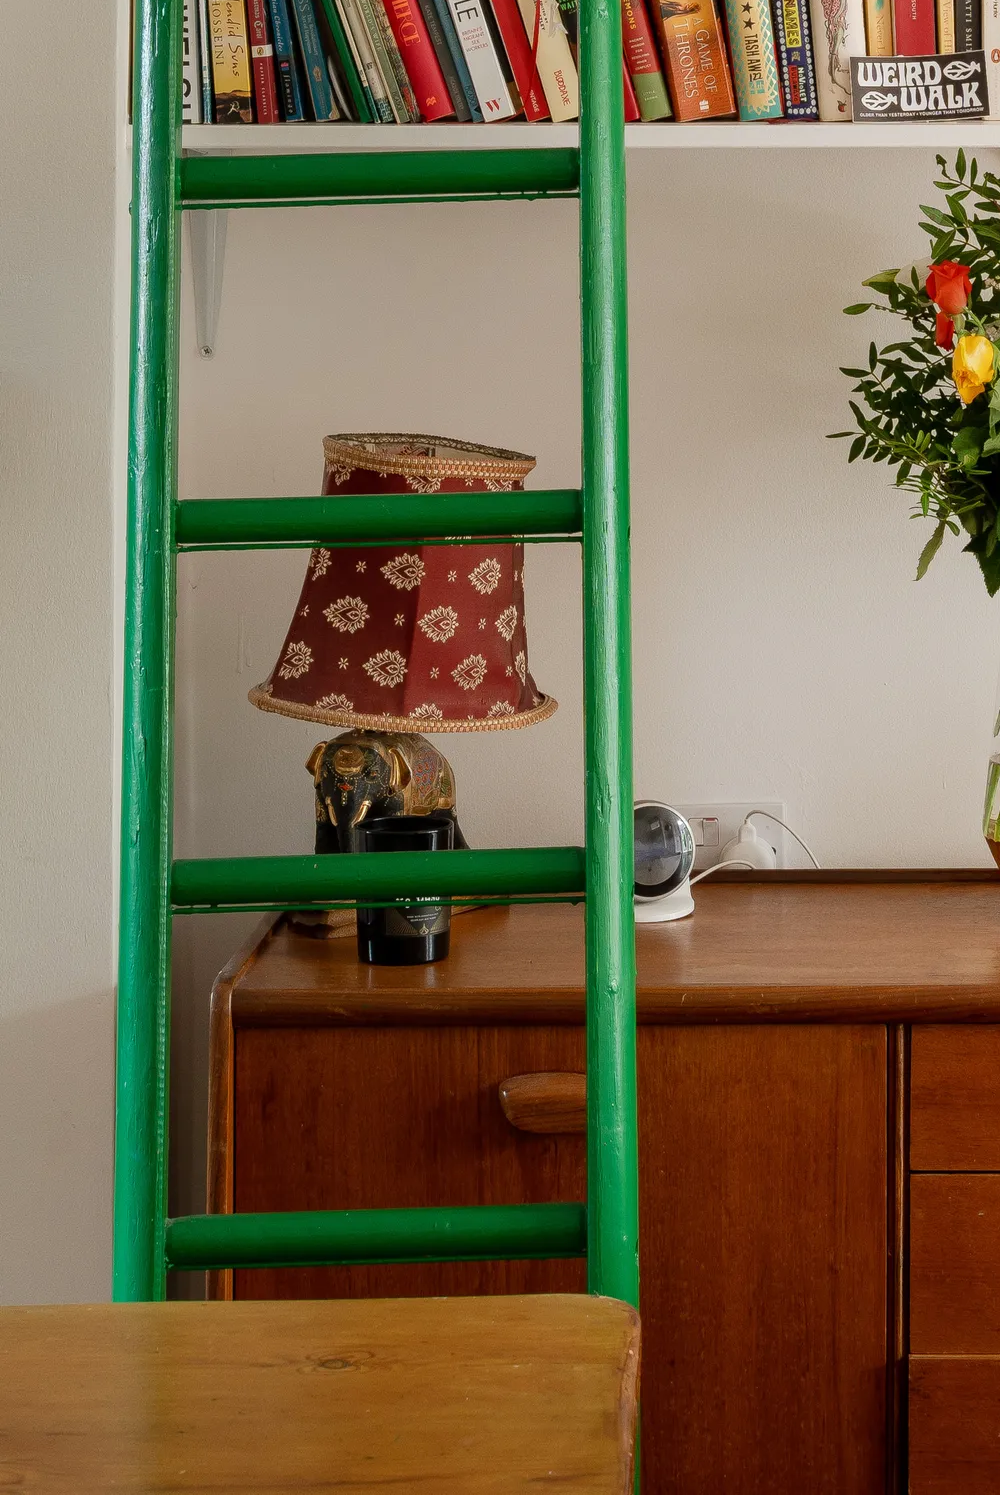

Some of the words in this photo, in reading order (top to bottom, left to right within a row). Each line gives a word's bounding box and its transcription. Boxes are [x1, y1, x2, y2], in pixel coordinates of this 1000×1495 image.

[693, 18, 704, 26] A
[230, 43, 244, 77] Suns
[672, 19, 699, 98] THRONES
[694, 29, 712, 72] GAME
[704, 75, 717, 93] OF
[858, 61, 942, 87] WEIRD
[900, 82, 982, 111] WALK
